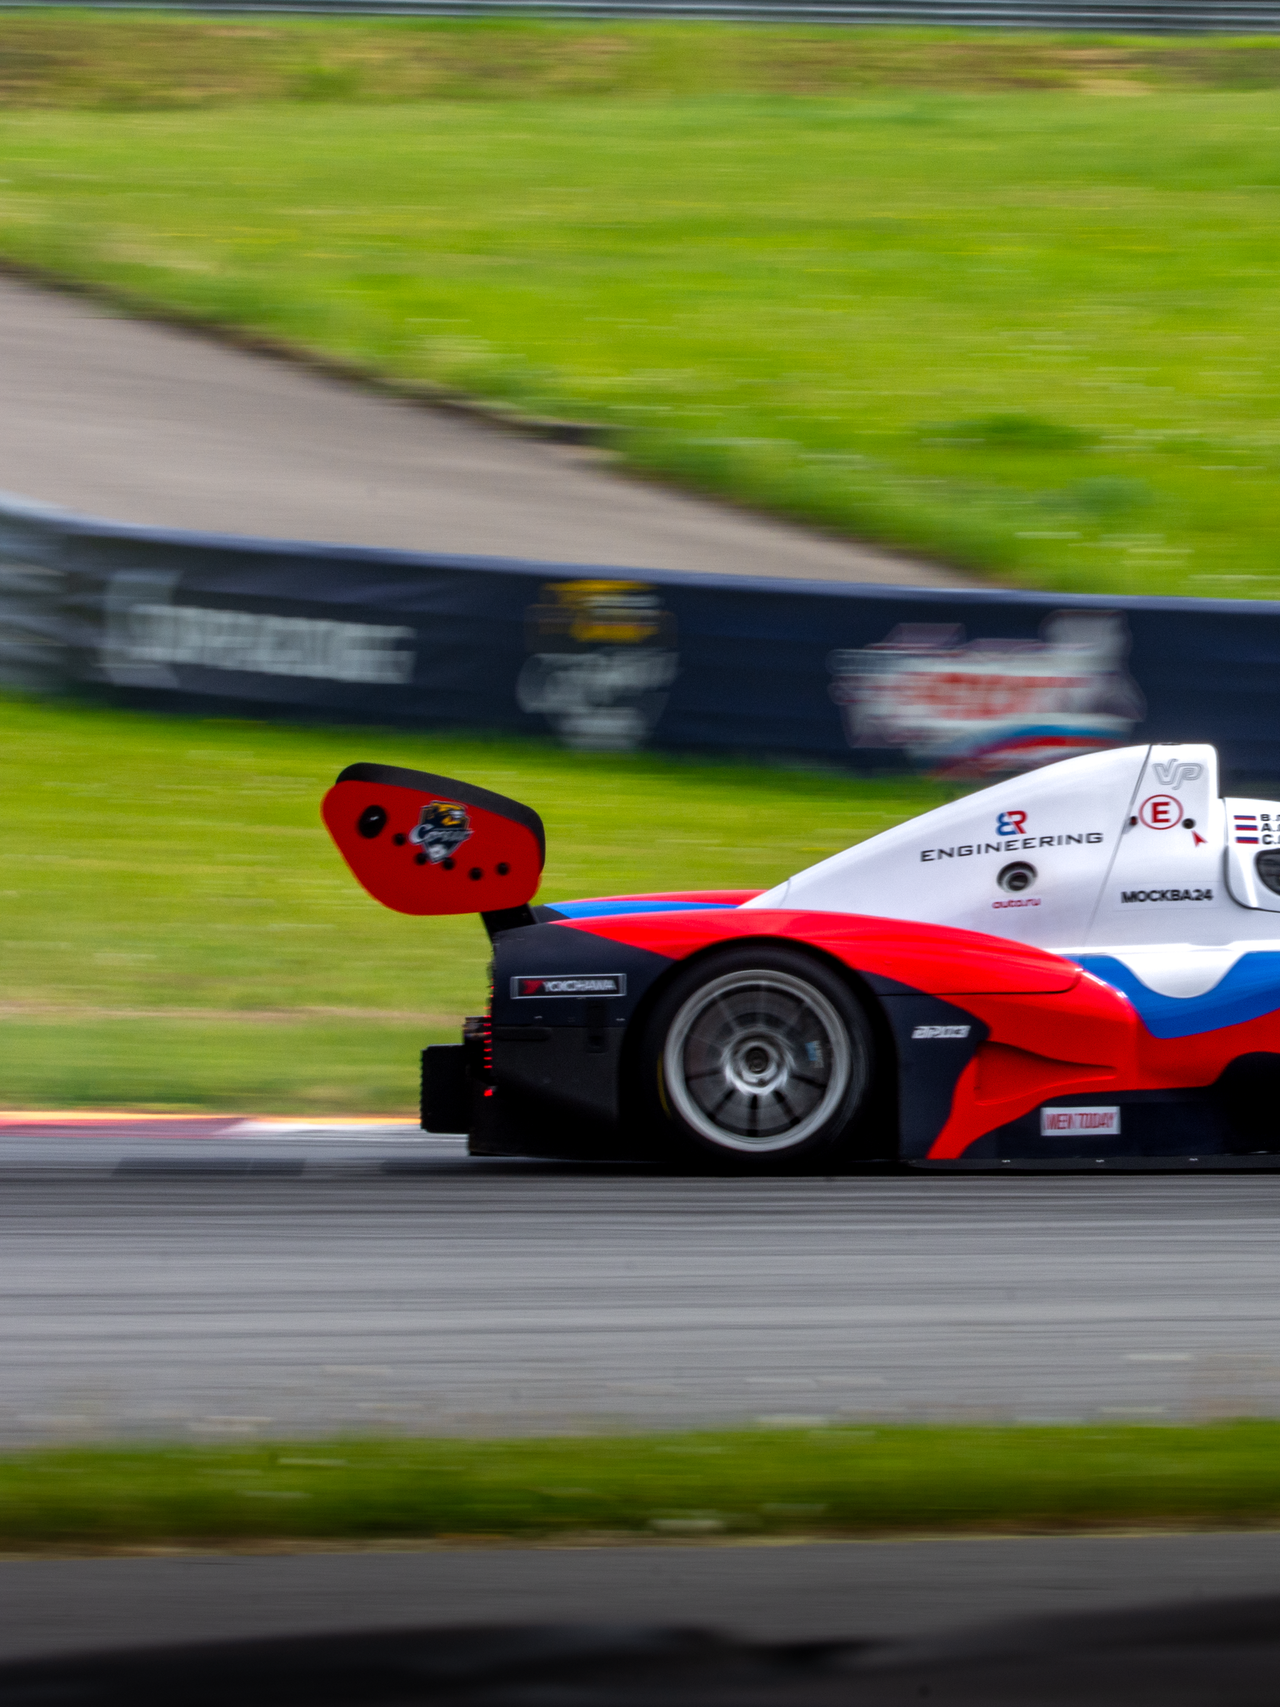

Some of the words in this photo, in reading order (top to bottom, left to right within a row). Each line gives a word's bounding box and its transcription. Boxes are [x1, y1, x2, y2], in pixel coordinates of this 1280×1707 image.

[996, 810, 1027, 836] BR
[1151, 801, 1171, 823] E
[920, 832, 1104, 862] ENGINEERING
[992, 898, 1041, 909] auto.ru
